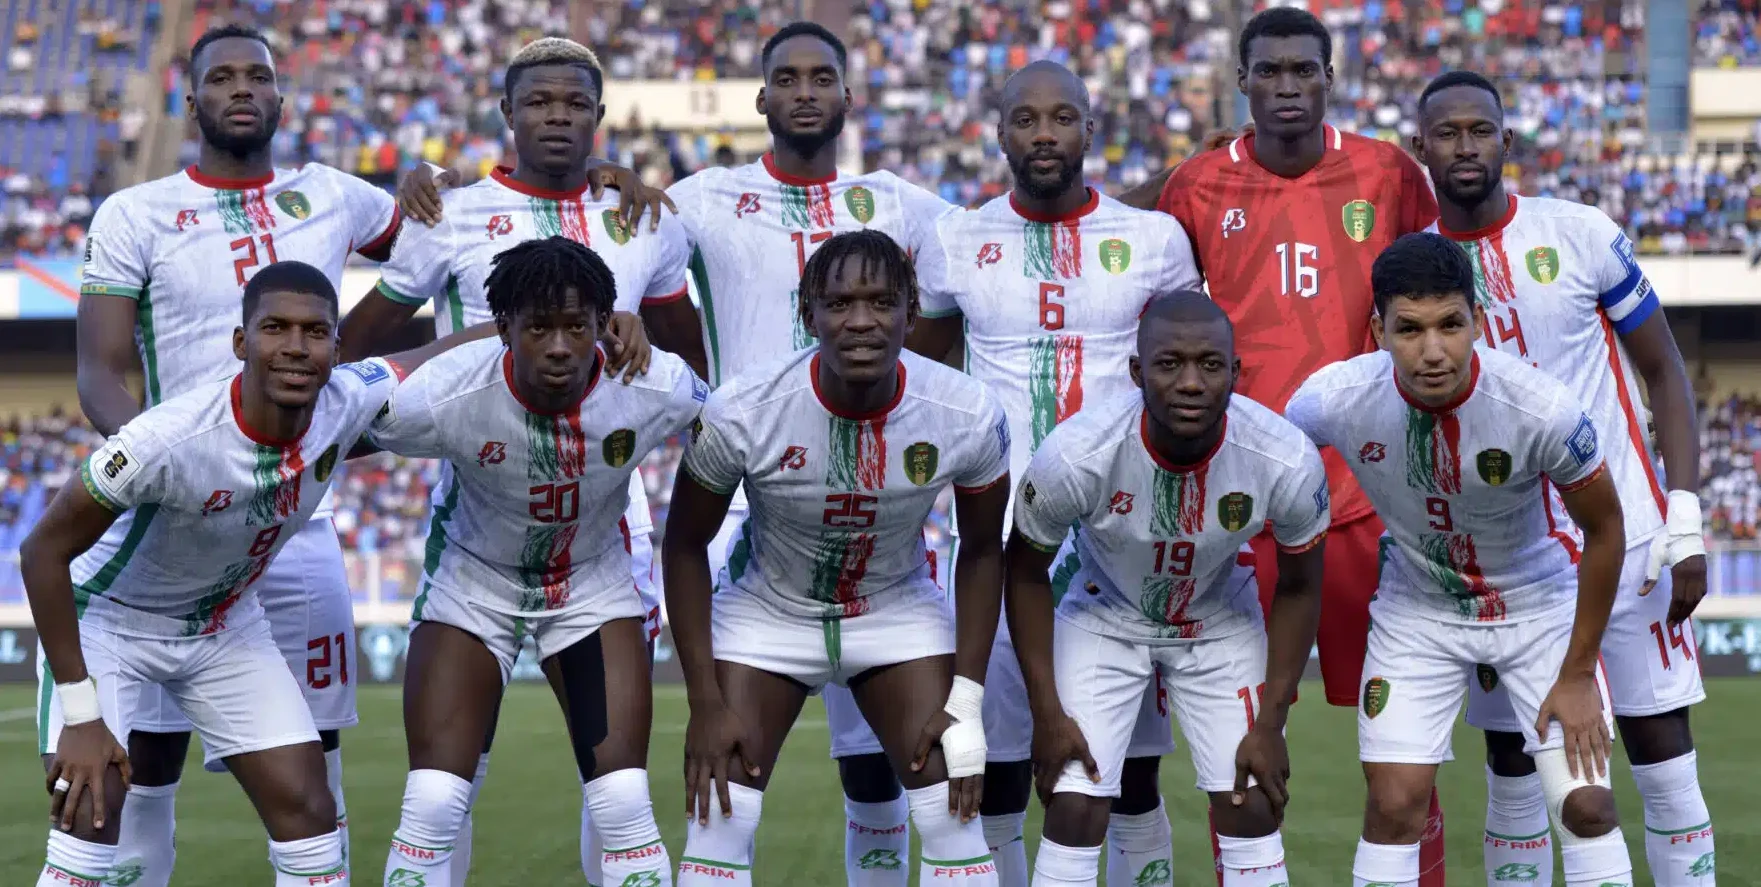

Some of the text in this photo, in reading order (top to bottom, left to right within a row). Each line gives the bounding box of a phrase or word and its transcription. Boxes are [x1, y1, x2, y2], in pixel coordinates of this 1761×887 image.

[1275, 242, 1319, 298] 16
[1039, 282, 1065, 331] 6
[1483, 306, 1529, 358] 14
[529, 481, 580, 523] 20
[823, 493, 878, 528] 25
[1426, 497, 1453, 532] 9
[248, 523, 283, 558] 8
[1153, 541, 1195, 577] 19
[307, 632, 348, 689] 21
[848, 820, 906, 836] FFRIM
[1484, 836, 1547, 850] FFRIM
[604, 844, 662, 863] FFRIM
